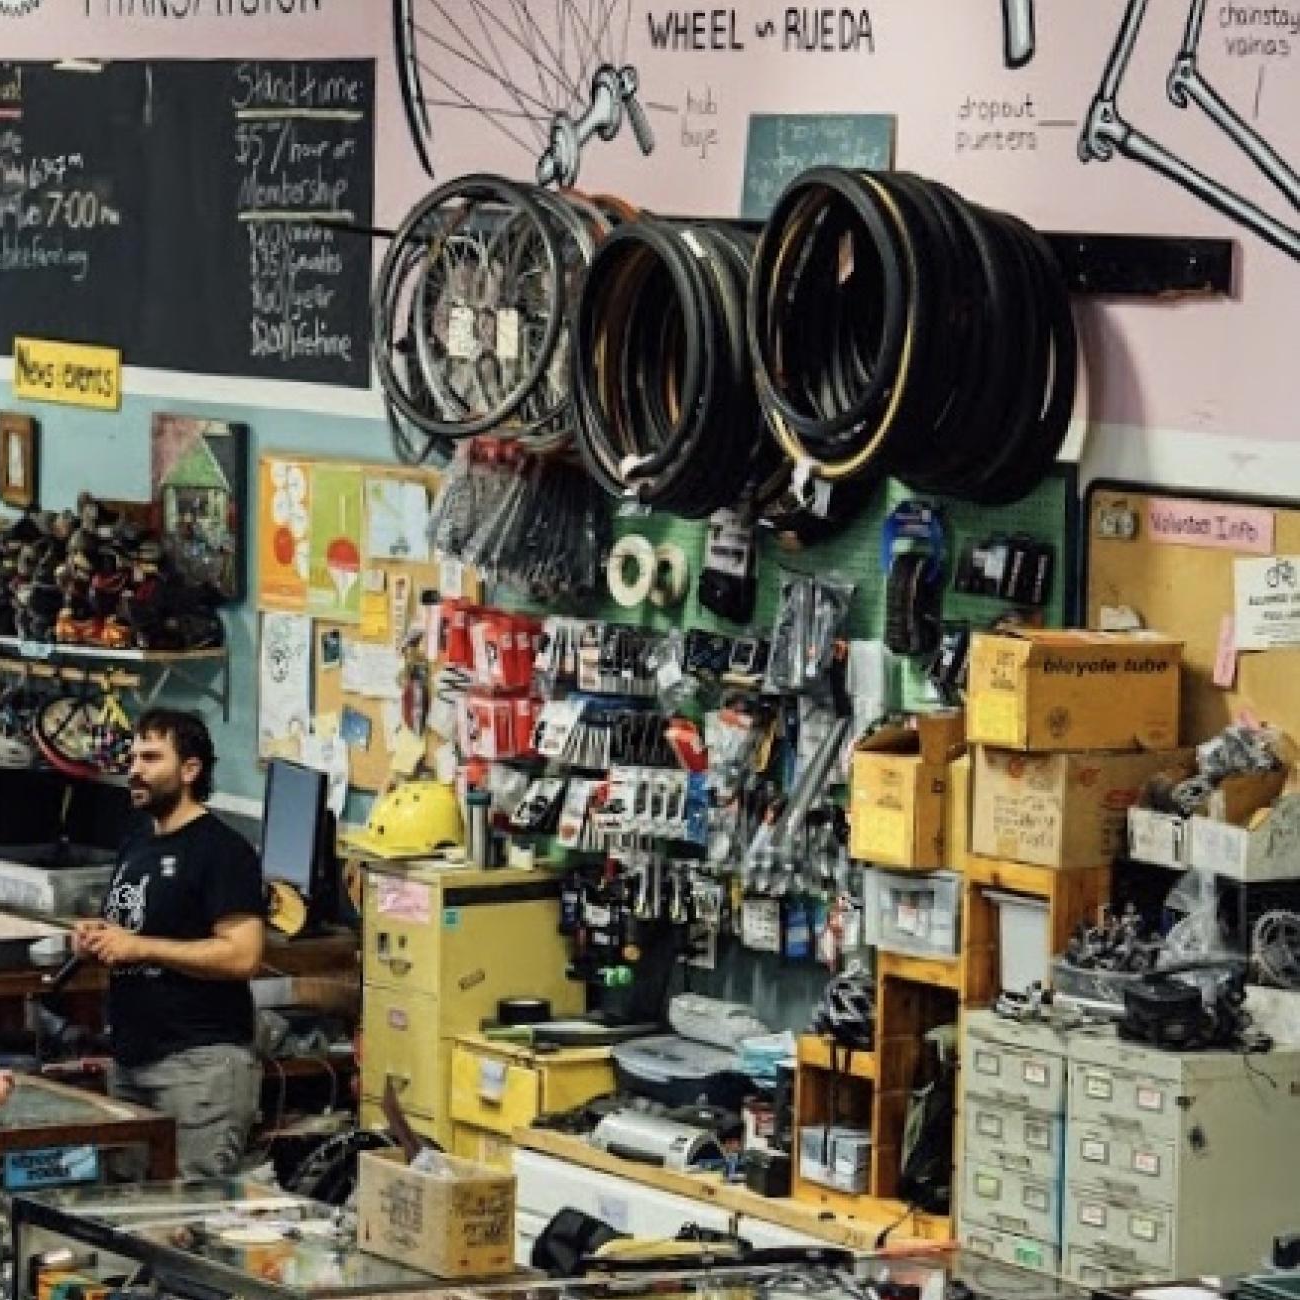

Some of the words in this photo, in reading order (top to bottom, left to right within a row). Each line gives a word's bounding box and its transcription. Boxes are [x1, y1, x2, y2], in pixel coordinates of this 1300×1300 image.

[645, 7, 745, 52] WHEEL
[782, 7, 876, 54] RUEDA
[1219, 3, 1300, 34] chainstay
[232, 61, 297, 108] Stand
[686, 82, 719, 115] hub
[956, 94, 1037, 124] dropout
[46, 190, 98, 228] 7:00
[1214, 514, 1260, 544] Info
[1043, 655, 1117, 677] bicycle
[1123, 656, 1170, 673] tube
